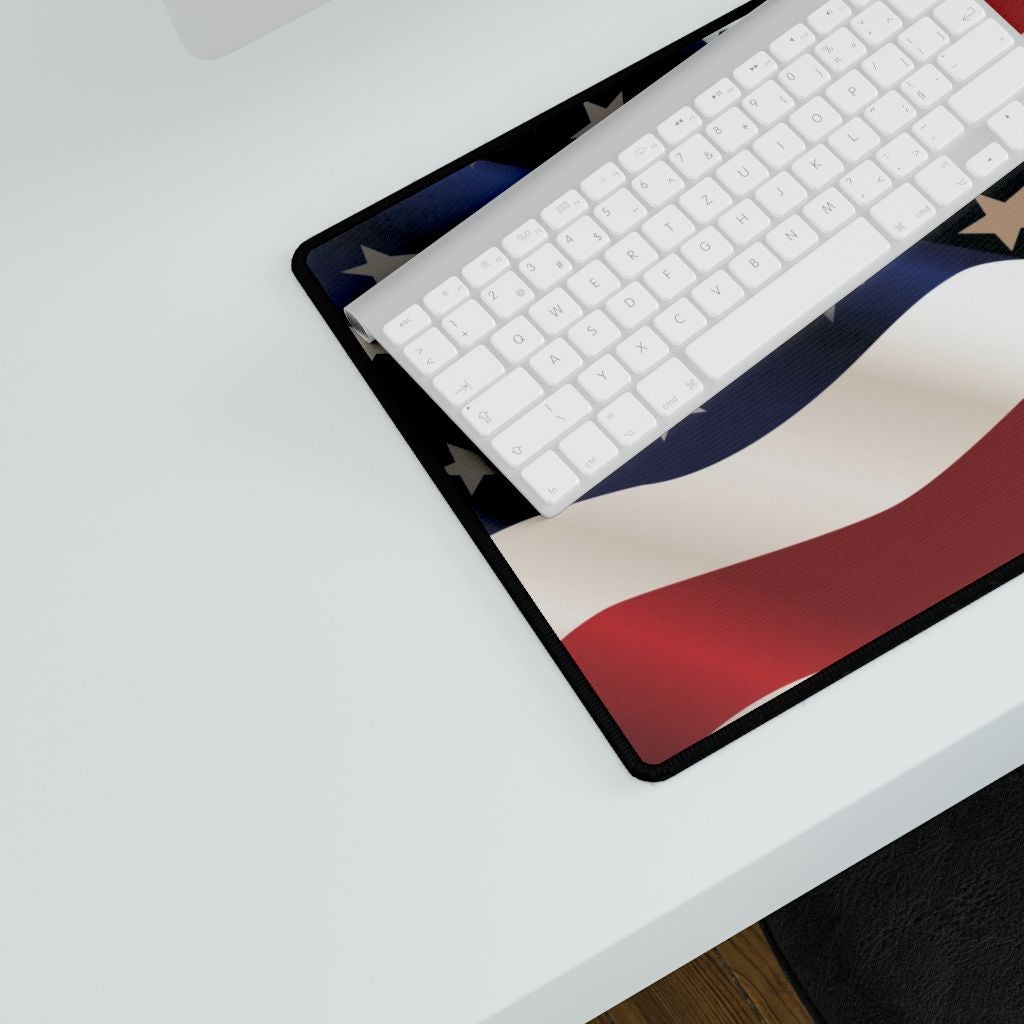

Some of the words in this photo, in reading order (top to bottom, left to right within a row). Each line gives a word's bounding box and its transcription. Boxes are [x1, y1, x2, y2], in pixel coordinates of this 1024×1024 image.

[488, 291, 499, 301] 2
[526, 263, 536, 272] 3
[565, 234, 574, 243] 4
[601, 207, 611, 216] 5
[640, 180, 649, 189] 6
[675, 152, 684, 162] 7
[713, 126, 722, 135] 8
[749, 99, 758, 108] 9
[786, 73, 796, 81] 0
[513, 334, 525, 344] Q
[549, 304, 563, 317] W
[589, 277, 600, 288] E
[626, 250, 639, 260] R
[664, 222, 674, 232] T
[701, 194, 713, 206] Z
[736, 166, 750, 178] U
[811, 112, 823, 123] O
[848, 86, 857, 96] P
[550, 354, 561, 365] A
[586, 326, 597, 336] S
[624, 297, 636, 308] D
[662, 269, 671, 279] F
[699, 240, 711, 252] G
[736, 213, 750, 224] H
[810, 158, 823, 169] K
[597, 370, 608, 380] Y
[635, 341, 648, 353] X
[674, 313, 685, 324] C
[710, 285, 721, 295] V
[748, 258, 760, 269] B
[784, 229, 798, 241] N
[821, 201, 836, 215] M
